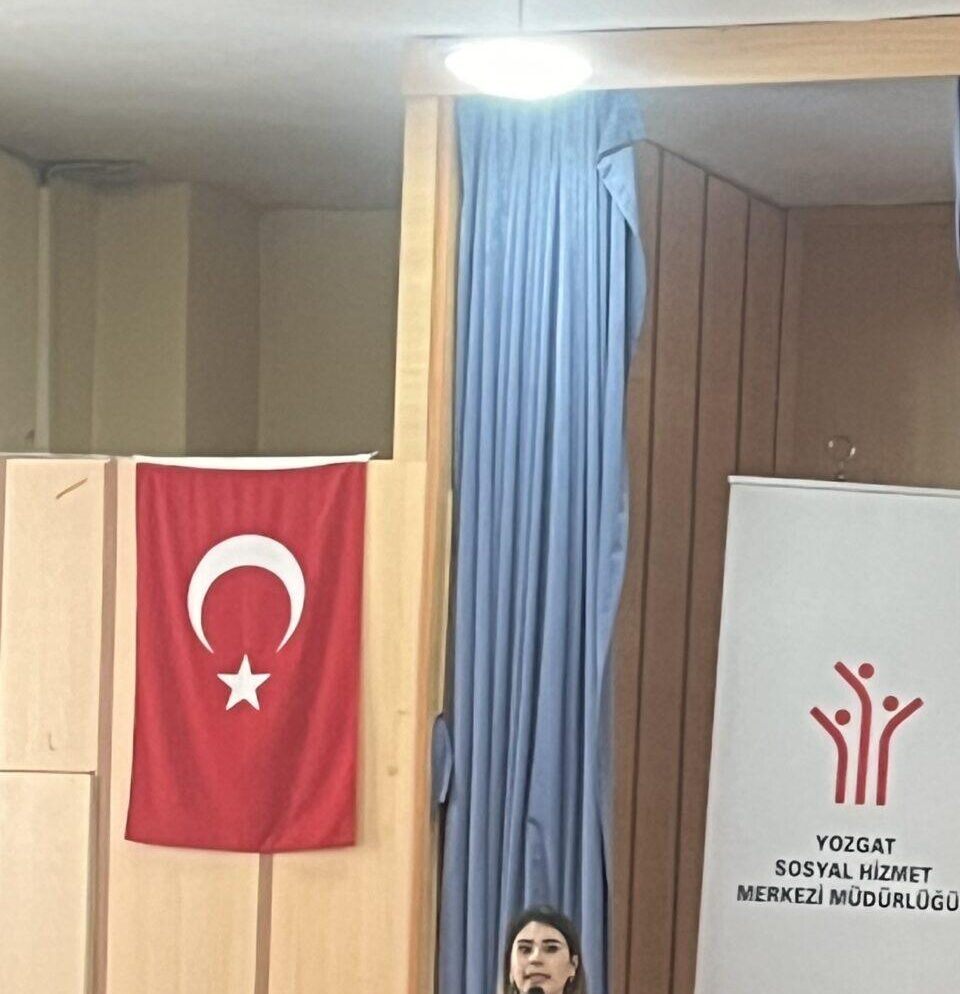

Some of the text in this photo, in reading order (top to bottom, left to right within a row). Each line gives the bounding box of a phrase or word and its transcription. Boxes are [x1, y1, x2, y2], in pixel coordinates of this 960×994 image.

[816, 834, 897, 855] YOZGAT
[775, 858, 933, 884] SOSYAL HİZMET
[736, 883, 960, 912] MERKEZİ MÜDÜRLÜĞÜ
